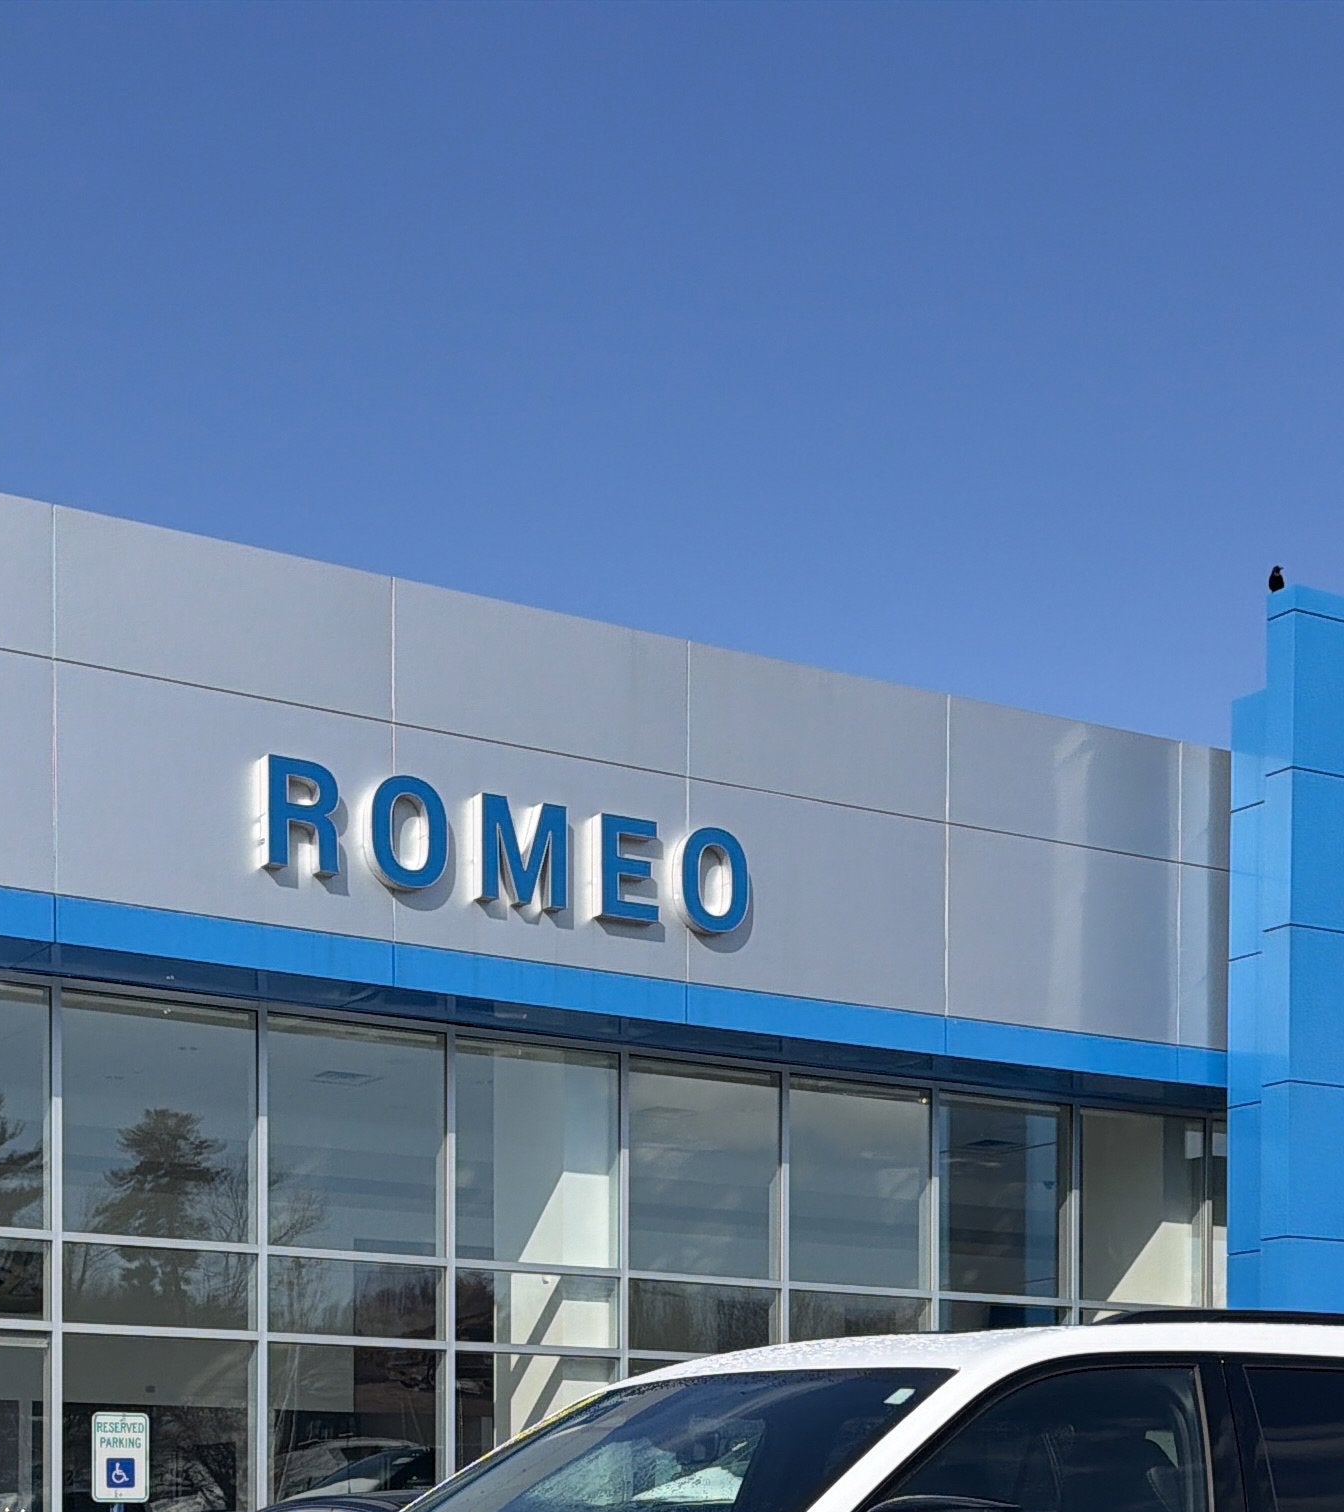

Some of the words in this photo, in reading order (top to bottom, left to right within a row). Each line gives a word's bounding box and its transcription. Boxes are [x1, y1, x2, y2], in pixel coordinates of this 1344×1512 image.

[258, 753, 752, 934] ROMEO
[96, 1421, 145, 1433] RESERVED
[99, 1437, 142, 1449] PARKING
